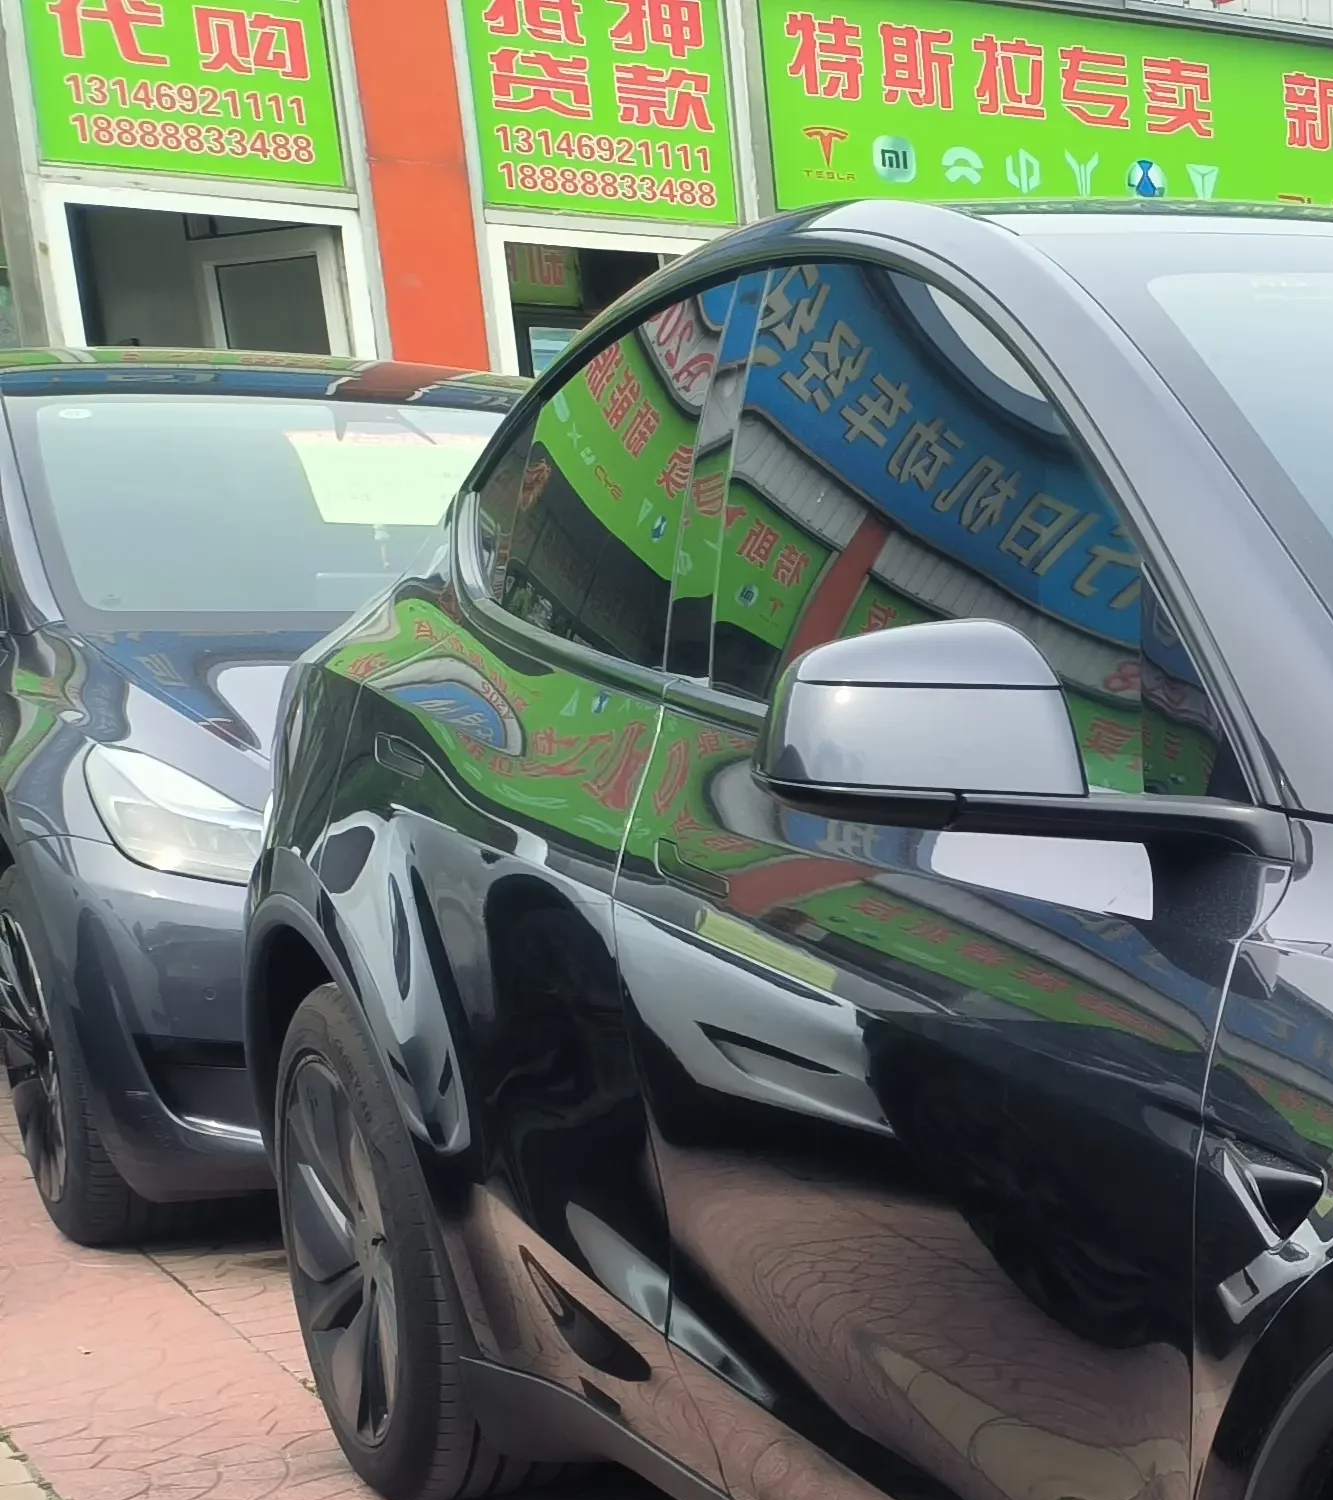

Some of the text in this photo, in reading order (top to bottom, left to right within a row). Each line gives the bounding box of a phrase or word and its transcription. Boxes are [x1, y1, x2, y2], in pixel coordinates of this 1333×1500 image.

[64, 73, 306, 125] 13146921111
[488, 47, 715, 132] 贷款
[784, 12, 1214, 139] 特斯拉专卖
[70, 113, 315, 164] 18888833488
[495, 124, 711, 173] 13146921111
[498, 161, 717, 207] 18888833488
